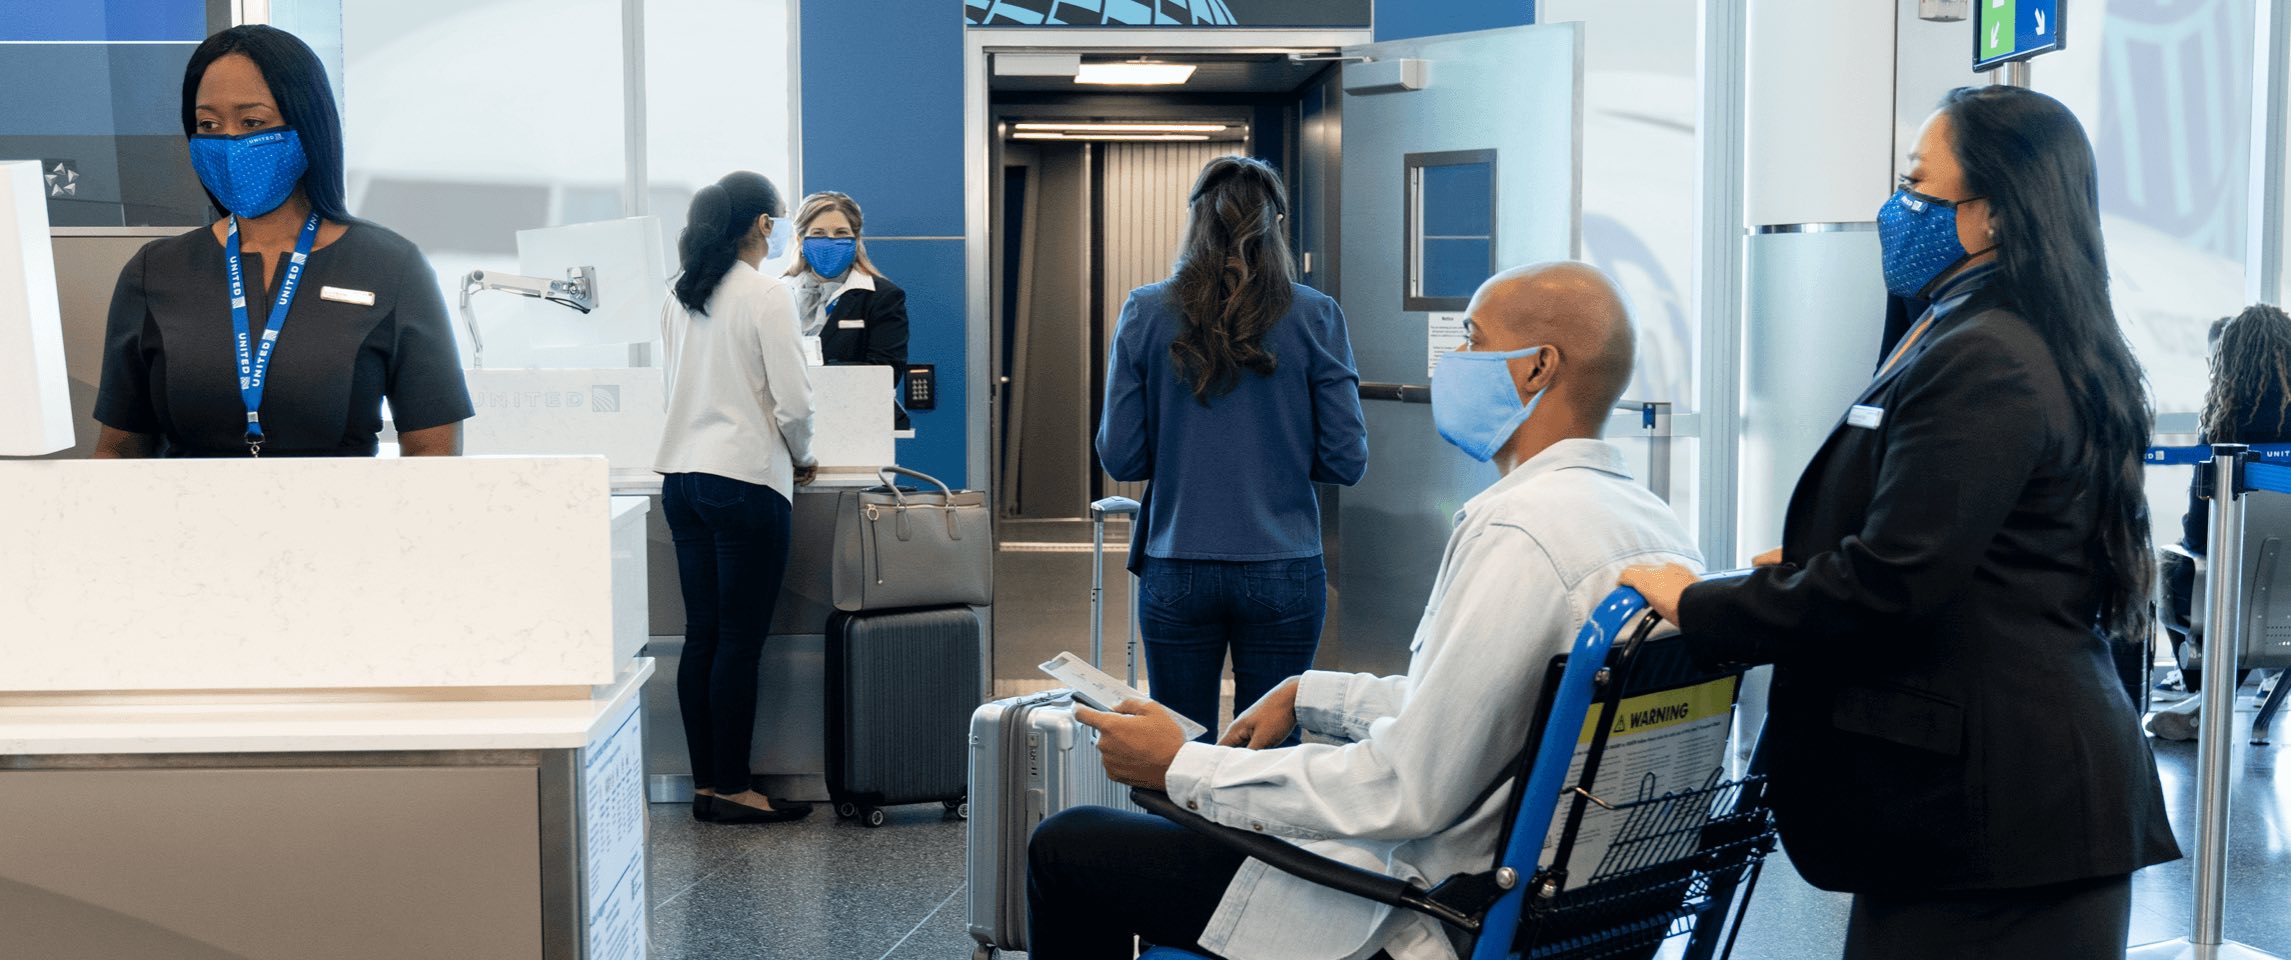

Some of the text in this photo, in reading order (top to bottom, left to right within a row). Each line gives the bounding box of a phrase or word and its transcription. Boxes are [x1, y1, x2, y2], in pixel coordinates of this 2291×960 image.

[229, 256, 241, 295] UNITED
[279, 265, 299, 305] UNITED
[238, 332, 250, 374] UNITED
[252, 342, 270, 387] UNITED
[1630, 702, 1689, 728] WARNING
